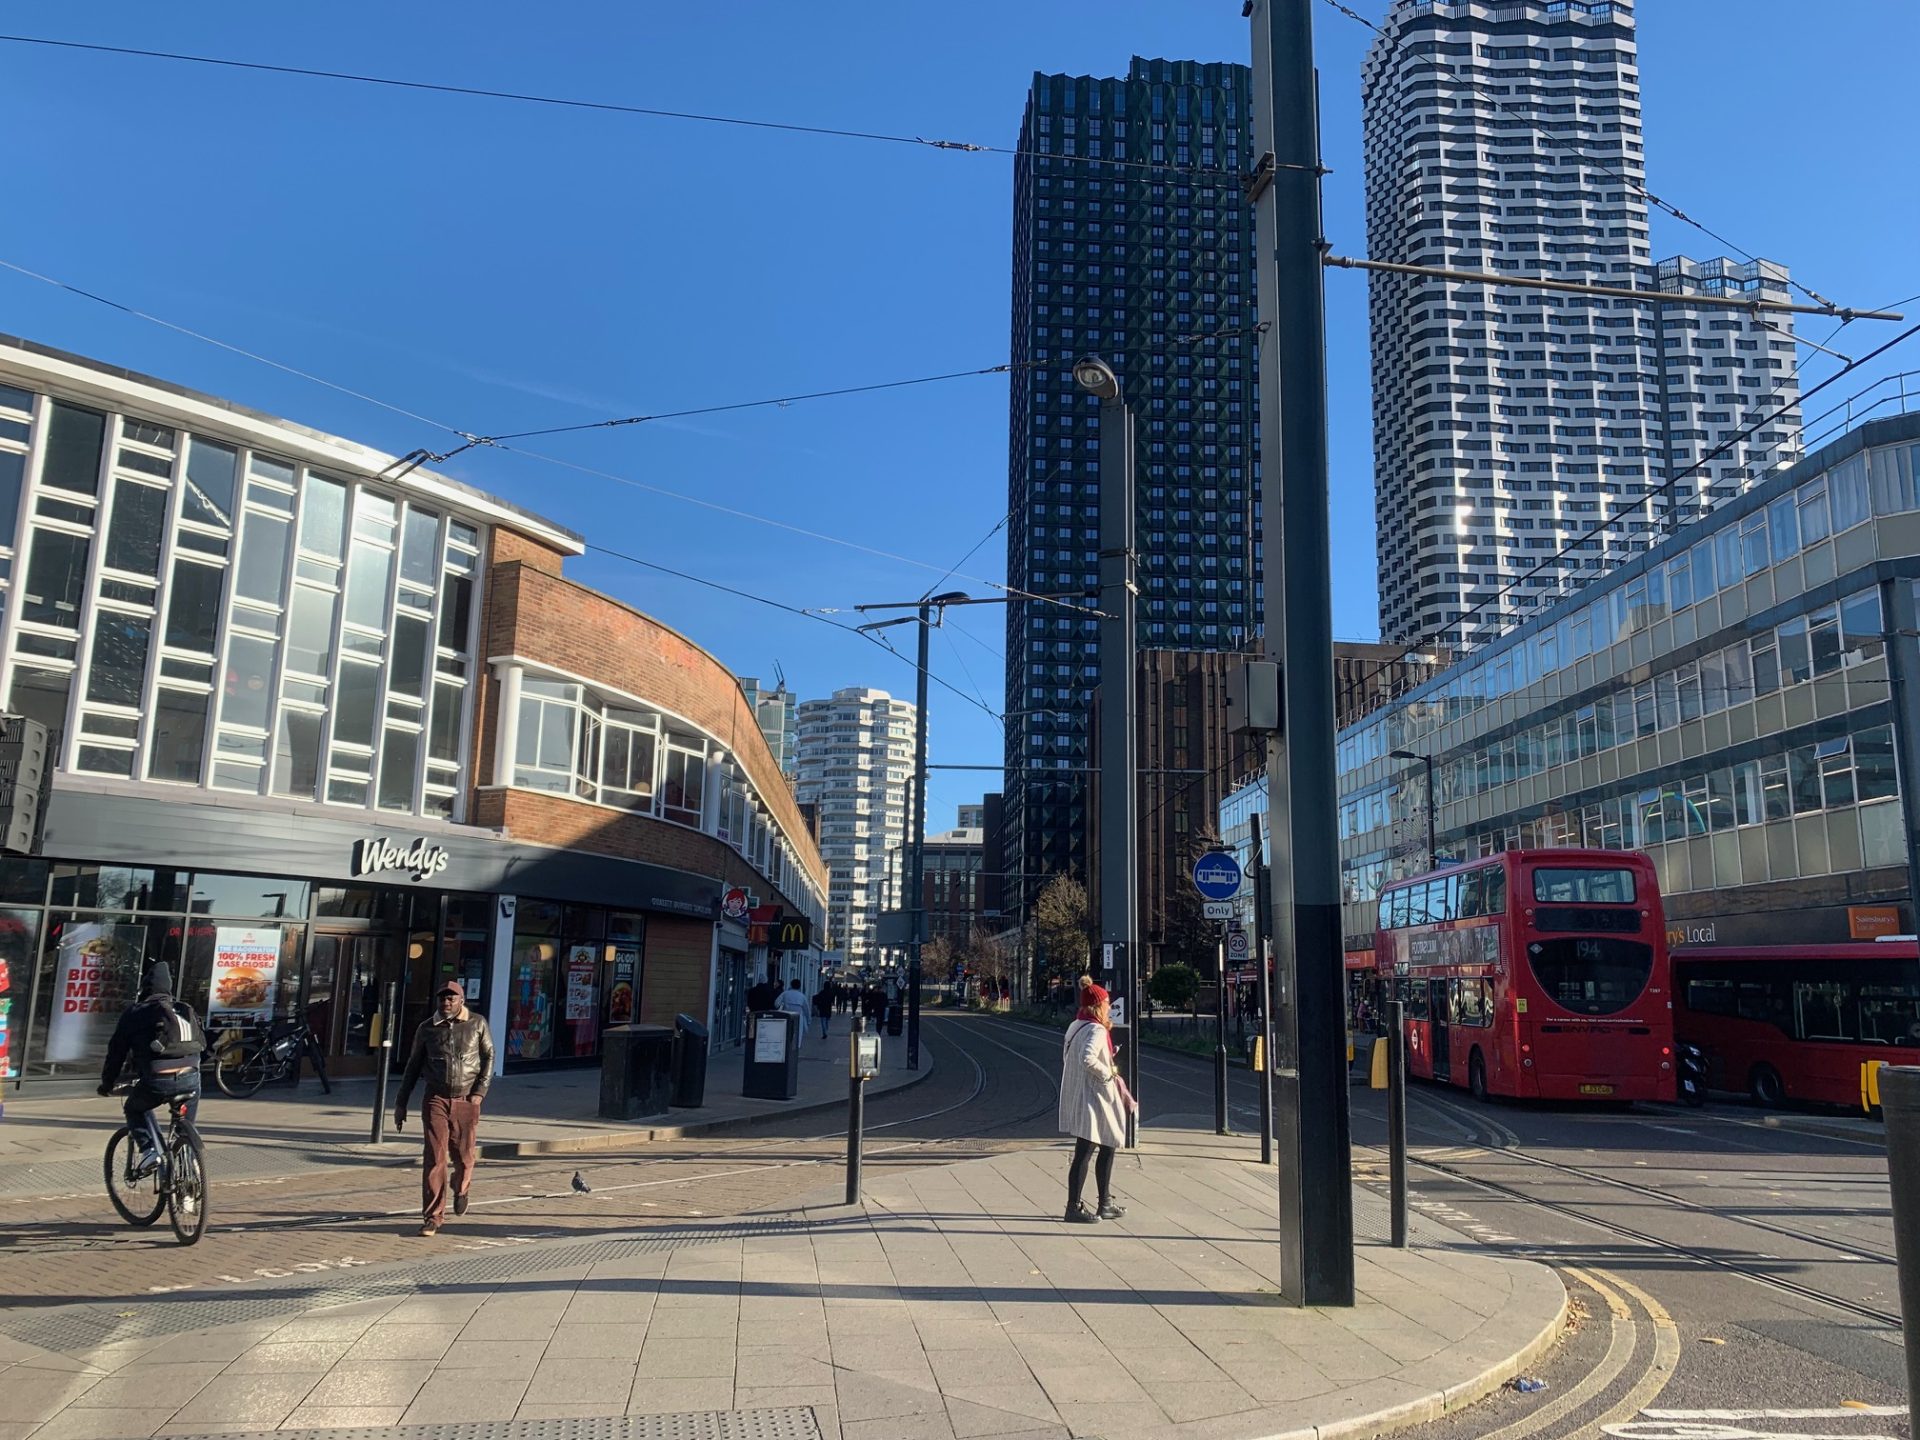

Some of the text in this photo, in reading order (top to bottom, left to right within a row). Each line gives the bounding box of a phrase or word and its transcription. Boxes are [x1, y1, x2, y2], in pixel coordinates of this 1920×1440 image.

[361, 838, 449, 879] Wendy's
[1207, 906, 1230, 915] Only
[1686, 923, 1717, 943] Local
[1576, 940, 1600, 957] 194
[218, 952, 276, 962] 100% FRESH
[217, 960, 241, 968] CASE
